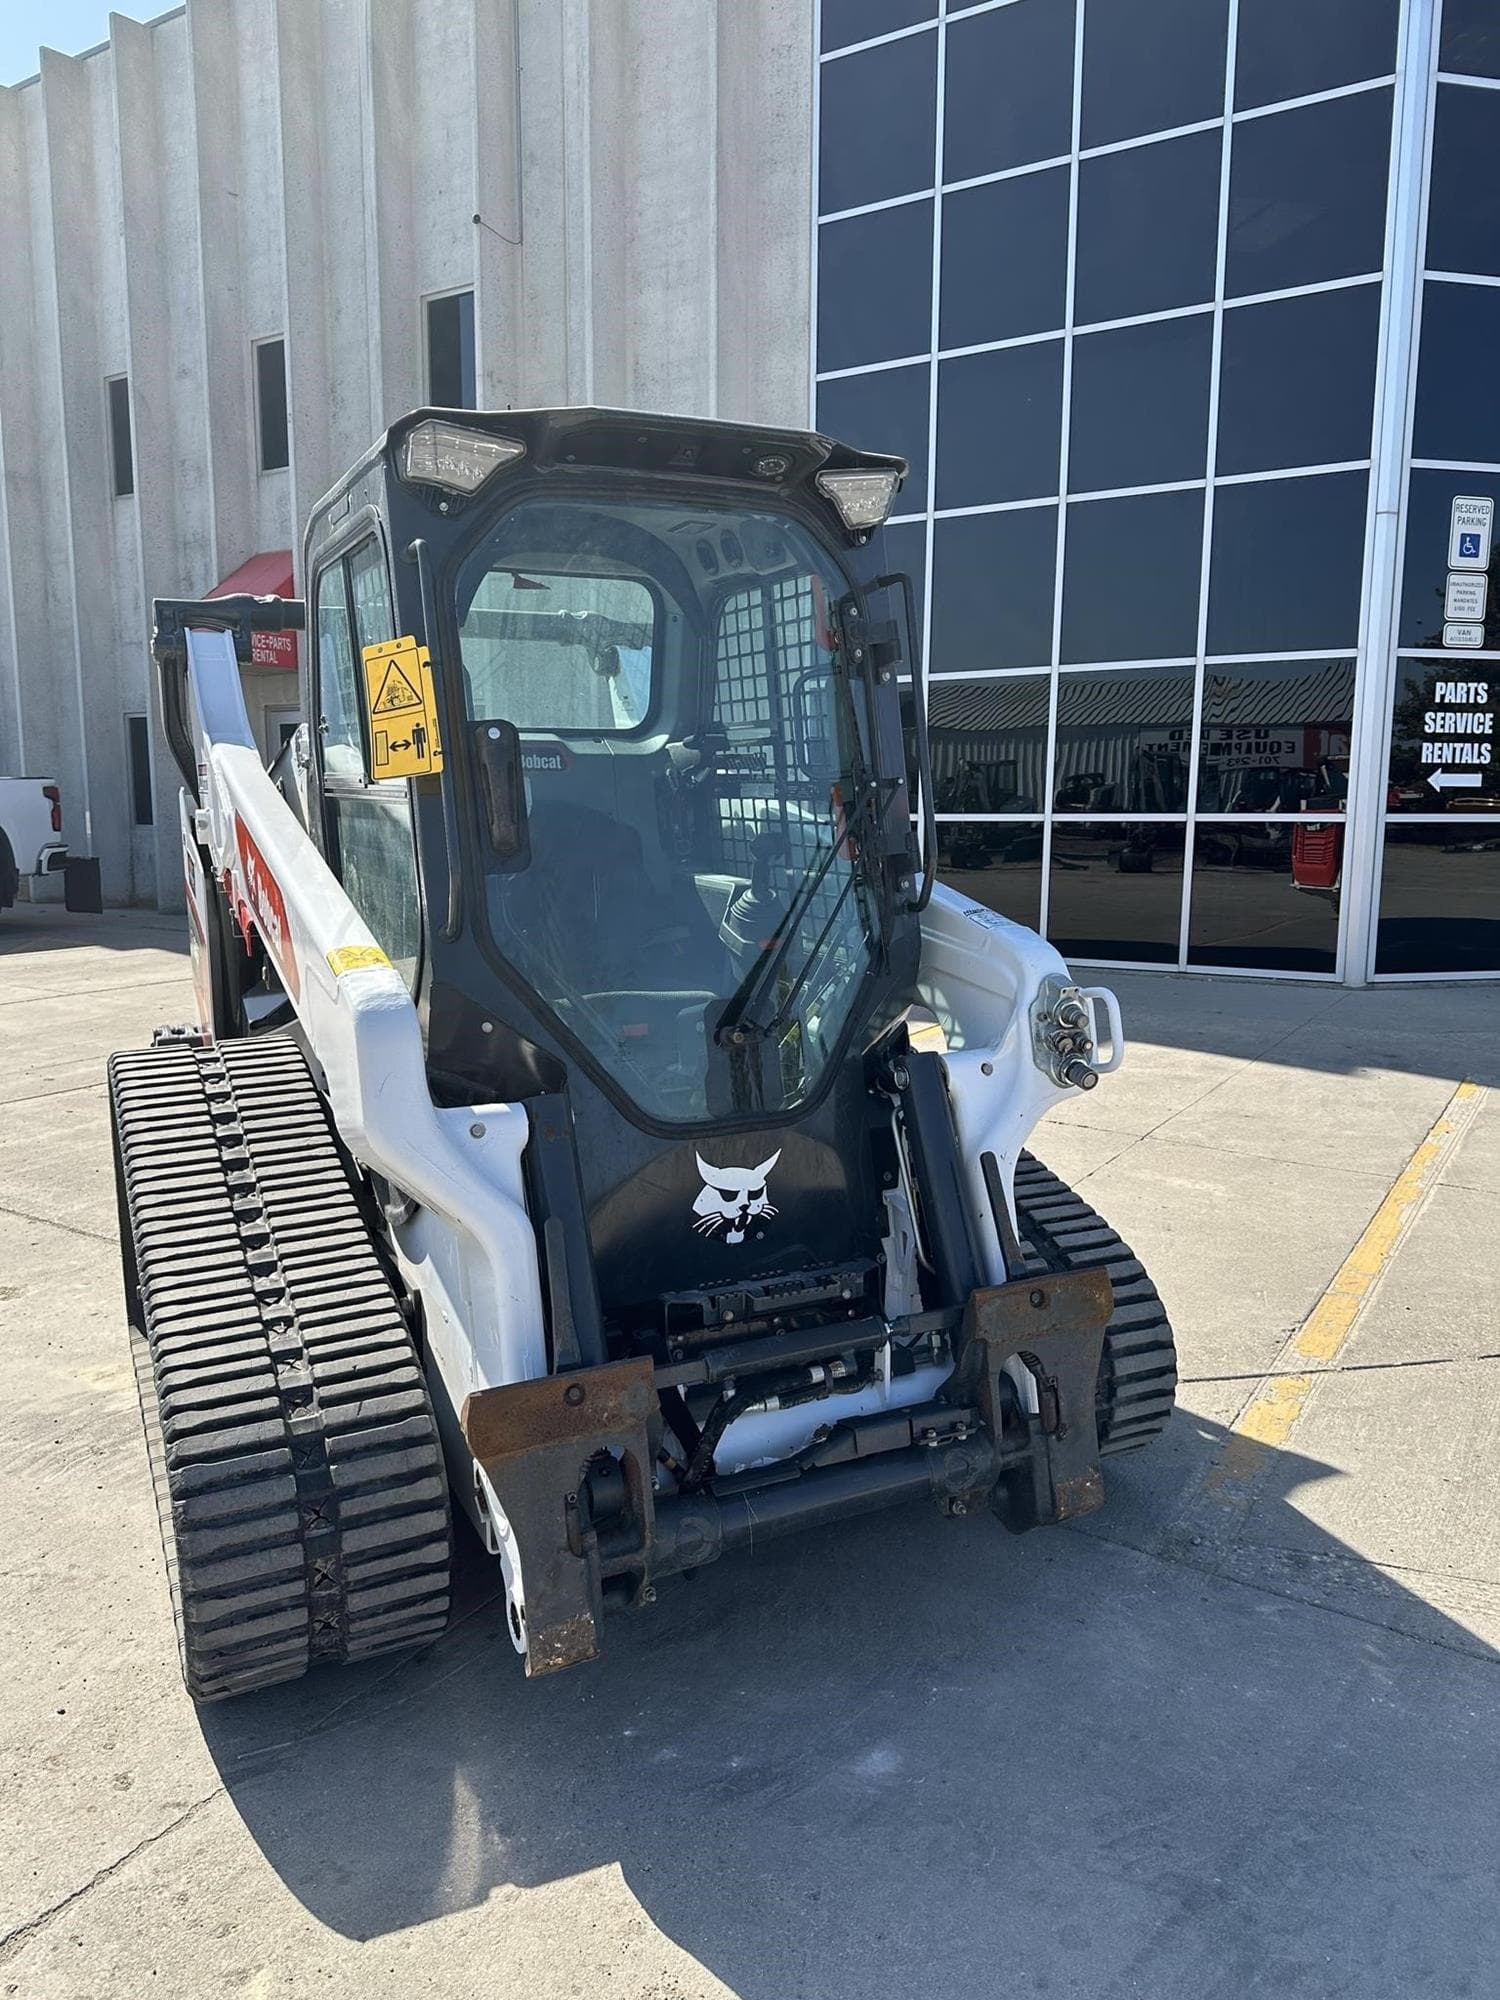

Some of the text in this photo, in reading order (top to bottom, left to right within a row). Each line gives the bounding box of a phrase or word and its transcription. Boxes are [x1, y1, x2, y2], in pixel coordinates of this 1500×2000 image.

[1455, 503, 1490, 515] RESERVED
[1456, 516, 1487, 527] PARKING
[251, 648, 279, 664] RENTAL
[1434, 681, 1489, 704] PARTS
[1424, 711, 1494, 734] SERVICE
[1421, 742, 1492, 764] RENTALS
